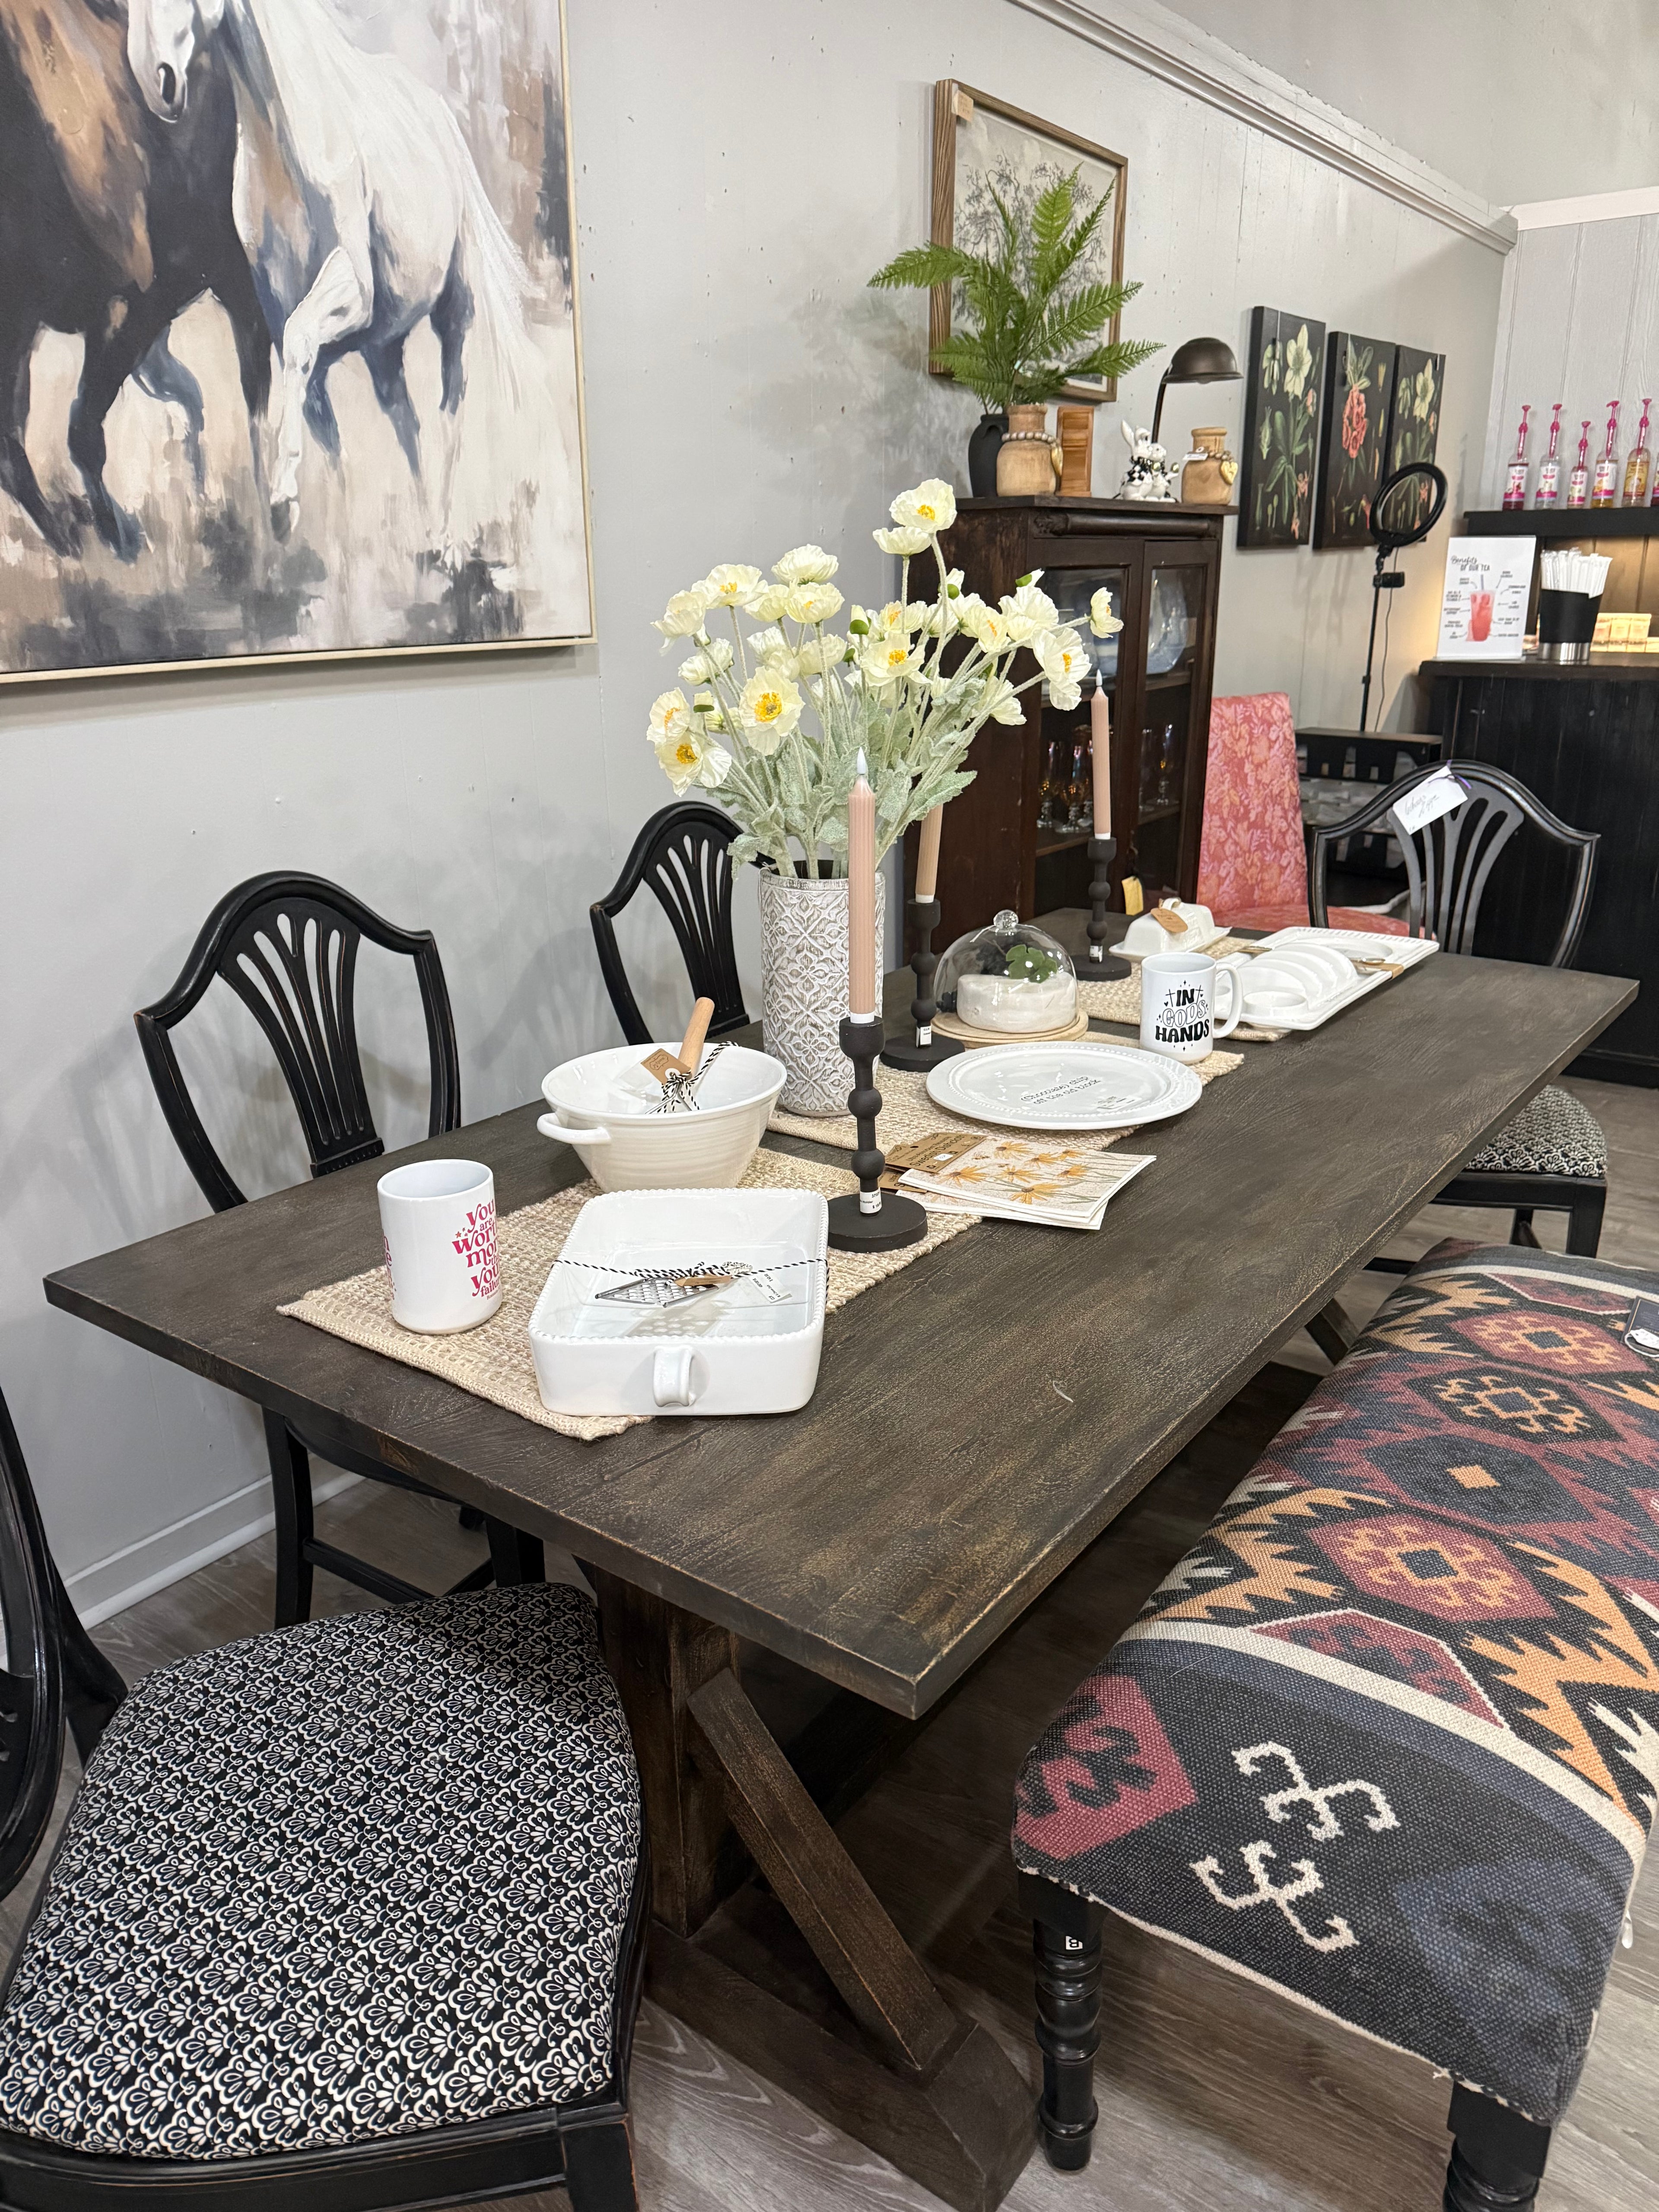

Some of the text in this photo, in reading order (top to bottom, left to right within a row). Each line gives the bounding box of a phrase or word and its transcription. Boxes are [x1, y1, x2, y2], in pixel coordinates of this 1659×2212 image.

[1451, 555, 1477, 565] Benefits
[1176, 988, 1195, 1007] IN
[1155, 1019, 1210, 1043] HANDS
[909, 1150, 941, 1166] Swedish
[466, 1199, 495, 1233] you
[480, 1217, 493, 1231] are
[466, 1238, 497, 1268] mor
